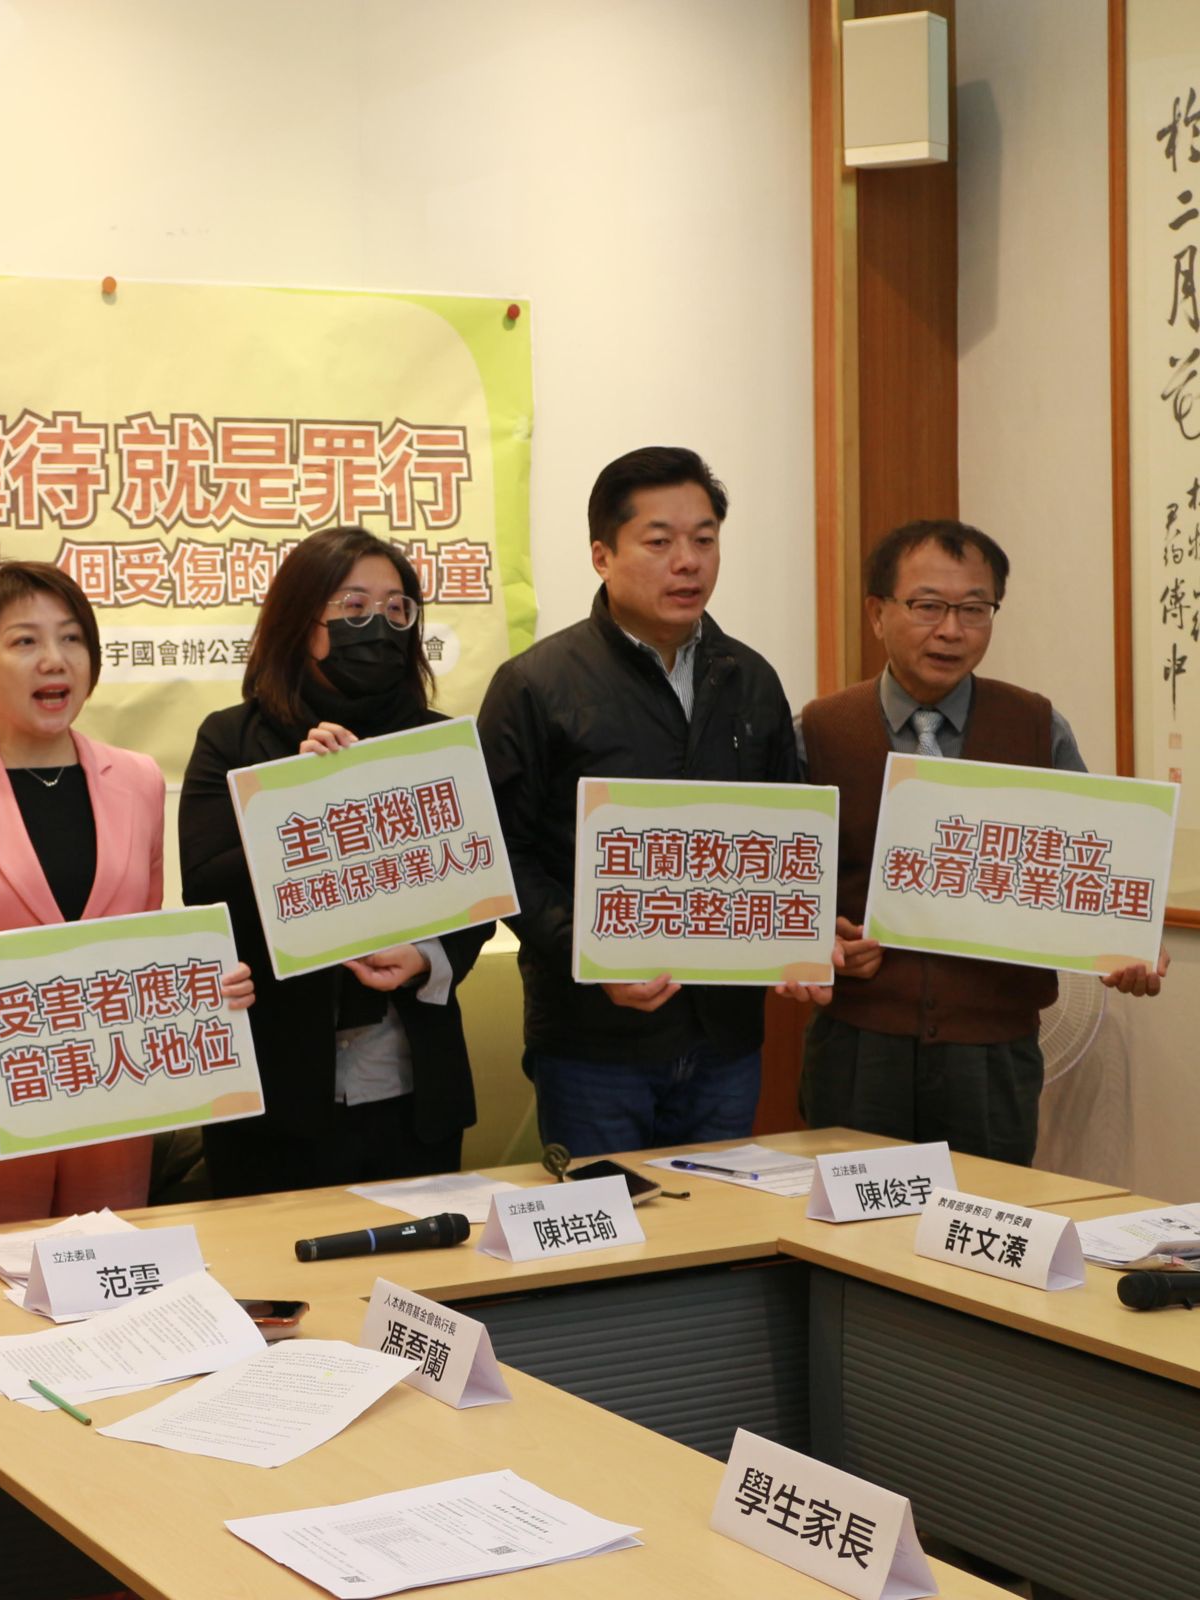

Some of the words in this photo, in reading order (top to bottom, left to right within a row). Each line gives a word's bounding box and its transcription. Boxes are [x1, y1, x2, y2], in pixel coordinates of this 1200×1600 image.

[113, 411, 471, 533] 就是罪行
[98, 638, 252, 668] 宇國會辦公室
[276, 776, 464, 872] 主管機關
[931, 814, 1113, 877] 立即建立
[273, 832, 495, 923] 應確保專業人力
[595, 826, 824, 885] 宜蘭教育處
[882, 845, 1154, 922] 教育專業倫理
[591, 884, 820, 942] 應完整調查
[0, 1015, 240, 1107] 當事人地位
[831, 1163, 868, 1178] 立法委員
[855, 1175, 933, 1213] 陳俊宇
[508, 1200, 545, 1216] 立法委員
[533, 1209, 618, 1251] 陳培瑜
[937, 1196, 993, 1220] 教育部學務司
[994, 1210, 1033, 1230] 專門委員
[52, 1248, 97, 1264] 立法委員
[96, 1263, 164, 1300] 范雲
[383, 1292, 458, 1338] 人本教育基金會執行長
[380, 1319, 452, 1384] 馮喬蘭
[734, 1466, 877, 1570] 學生家長
